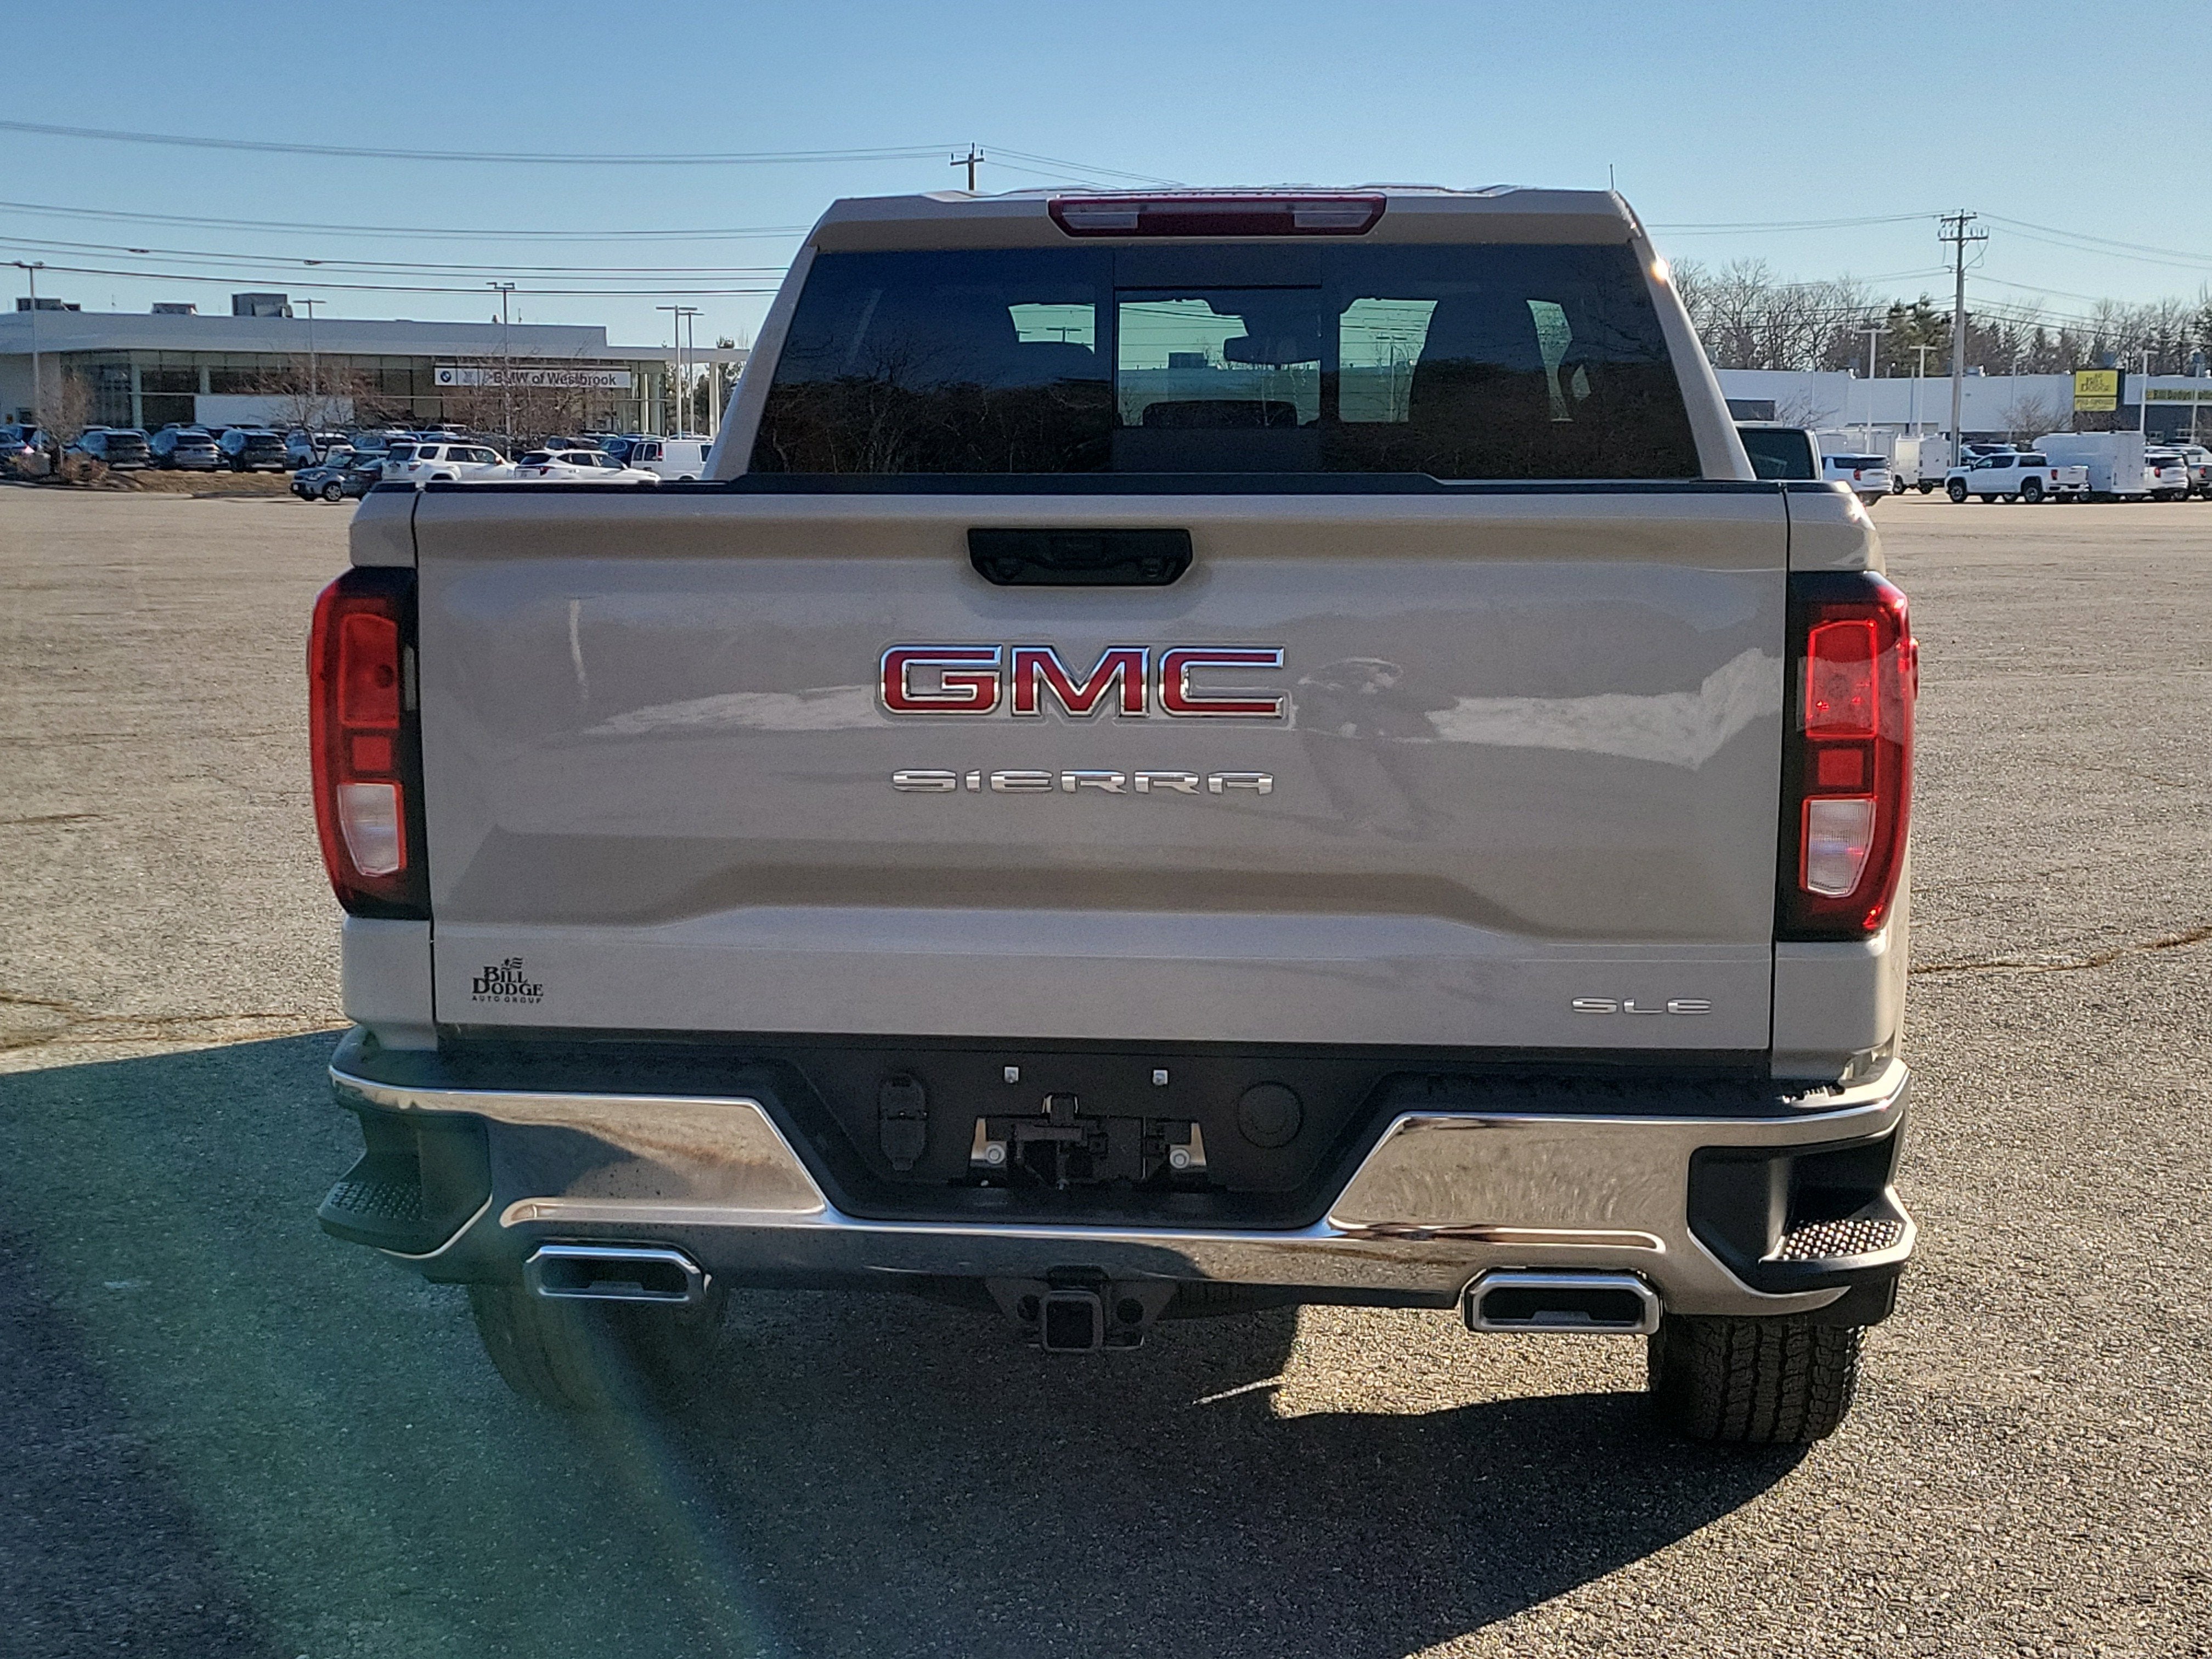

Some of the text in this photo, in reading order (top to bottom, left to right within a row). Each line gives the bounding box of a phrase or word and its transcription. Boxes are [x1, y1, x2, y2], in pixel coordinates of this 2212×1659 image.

[494, 371, 617, 385] BMW of Westbrook
[880, 644, 1284, 718] GMC
[892, 769, 1274, 795] SIERRA
[484, 966, 528, 983] BILL
[472, 978, 543, 996] DODGE
[1572, 997, 1712, 1015] SLE
